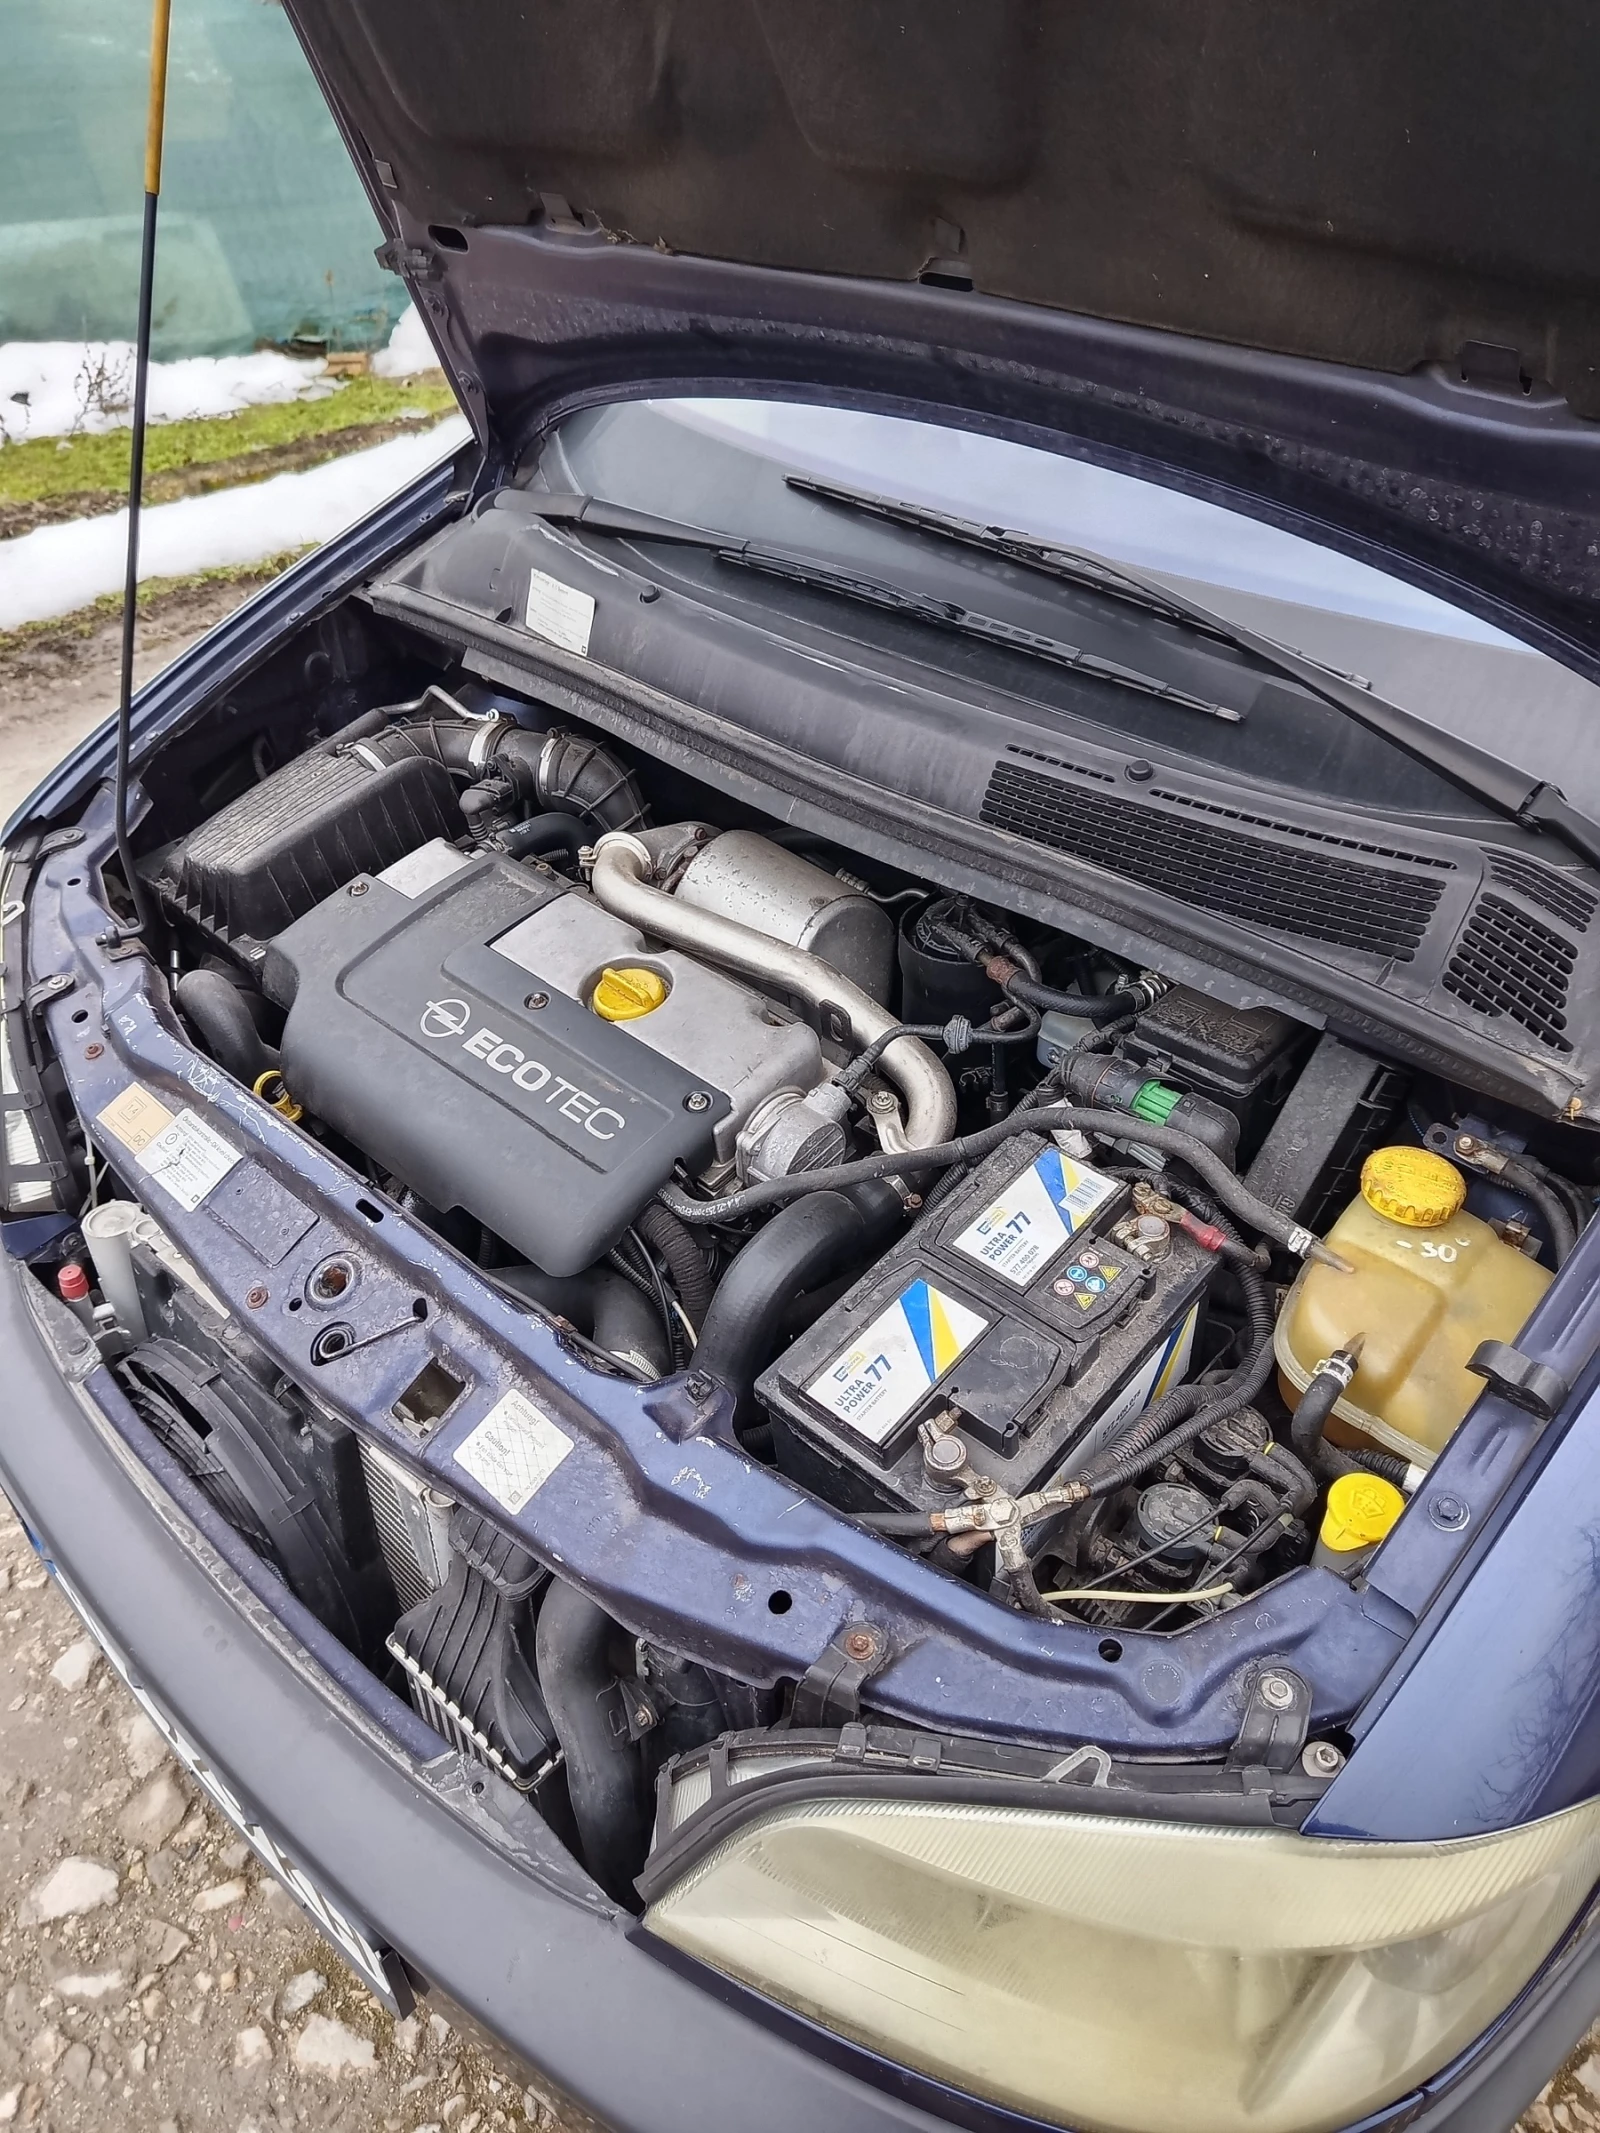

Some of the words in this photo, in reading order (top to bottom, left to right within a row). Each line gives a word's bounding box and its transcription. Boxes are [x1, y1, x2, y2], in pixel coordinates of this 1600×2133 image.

[462, 1027, 626, 1140] ECOTEC
[1005, 1211, 1032, 1234] 77
[980, 1232, 1007, 1256] ULTRA
[989, 1234, 1018, 1261] POWER
[863, 1353, 892, 1382] 77
[834, 1378, 864, 1407] ULTRA
[843, 1381, 876, 1414] POWER
